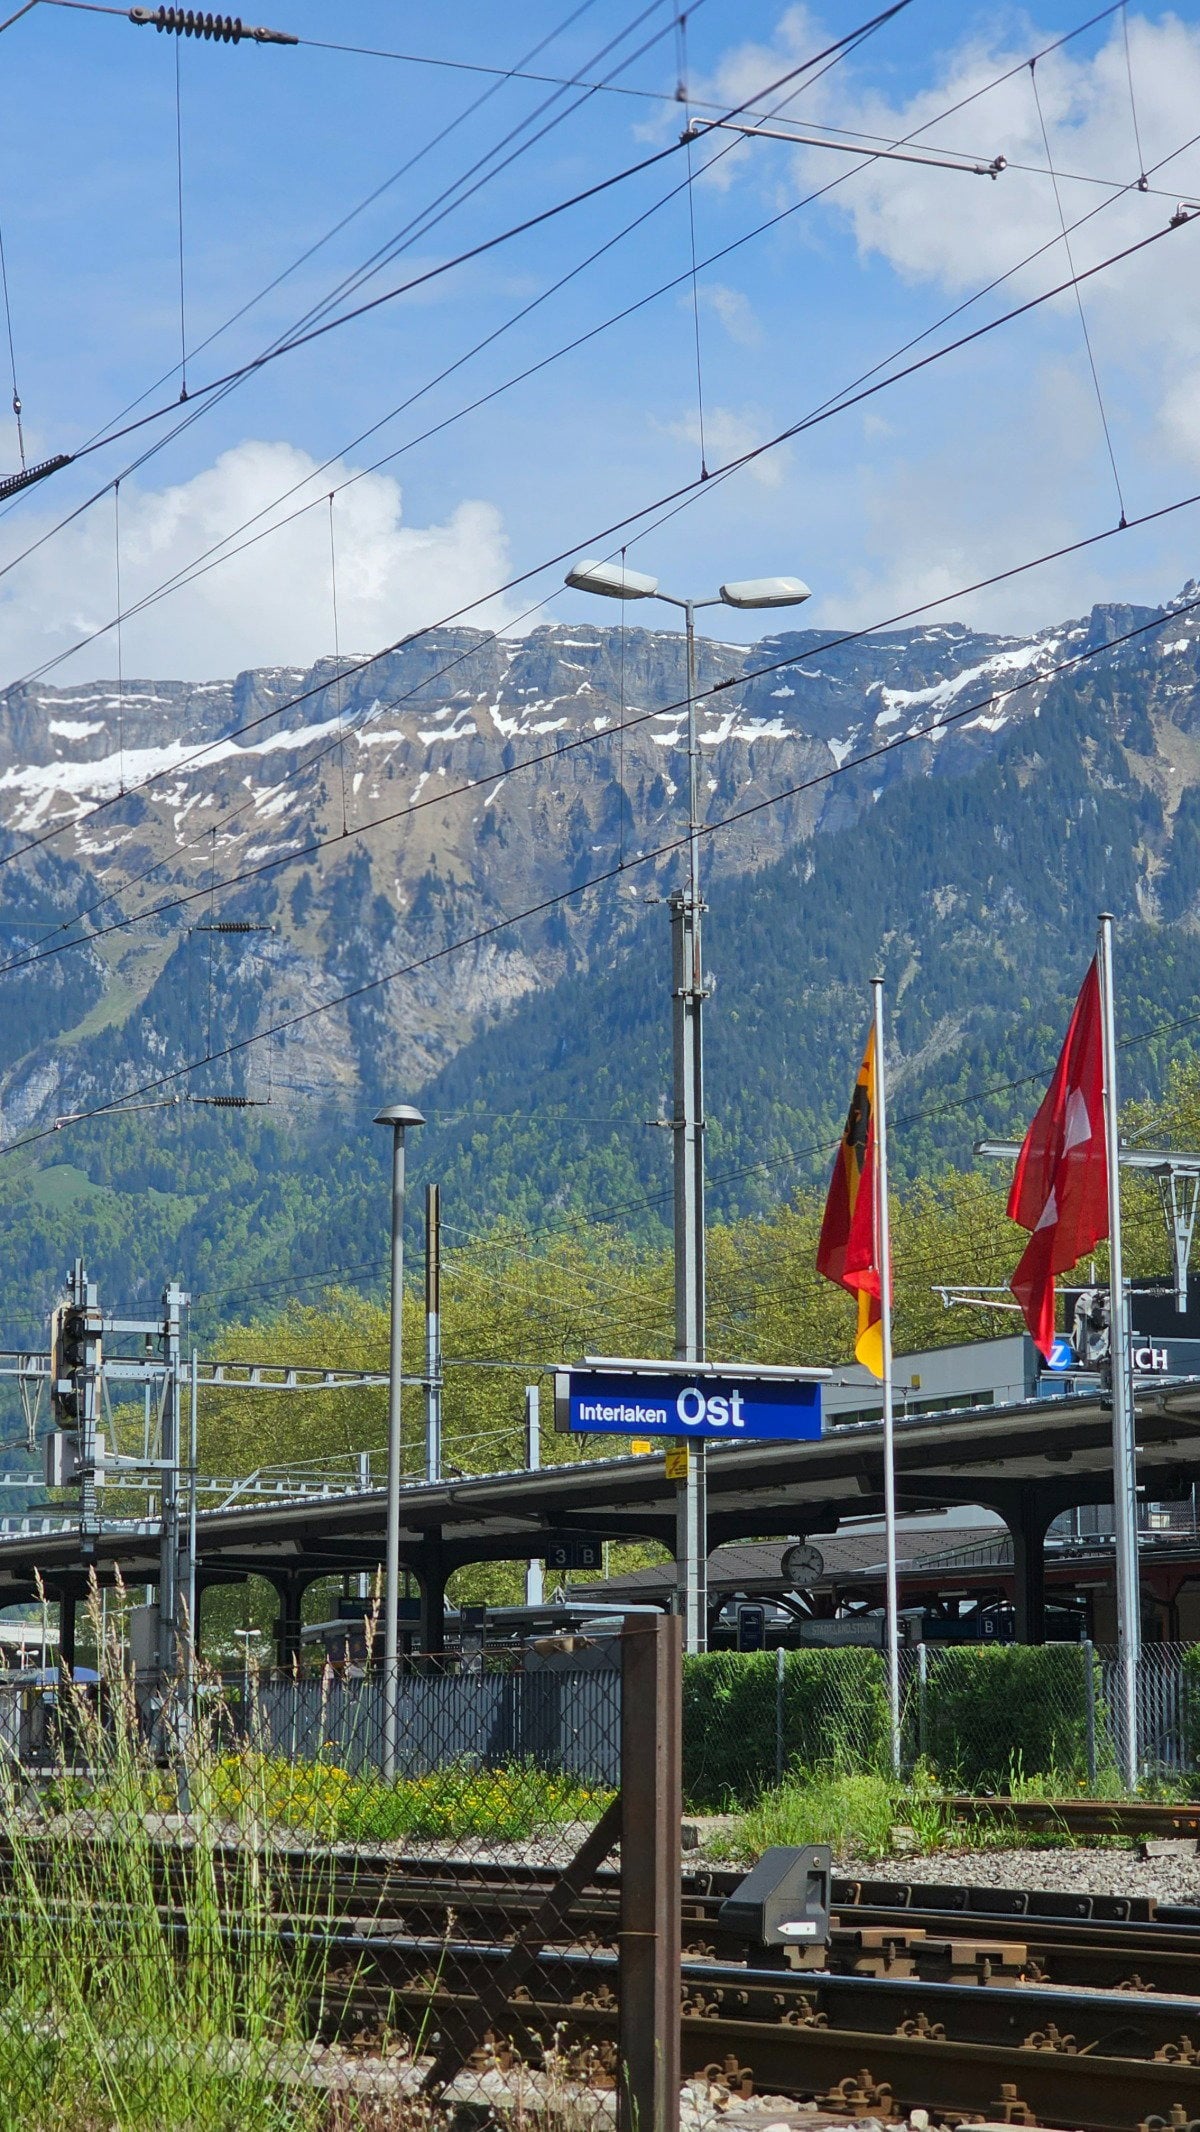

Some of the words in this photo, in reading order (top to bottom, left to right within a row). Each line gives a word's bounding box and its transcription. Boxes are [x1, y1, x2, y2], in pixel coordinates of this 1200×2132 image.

[1131, 1347, 1168, 1370] ICH
[579, 1403, 667, 1423] Interlaken
[676, 1387, 744, 1427] Ost
[556, 1549, 566, 1563] 3
[583, 1550, 594, 1563] B
[985, 1620, 993, 1633] B
